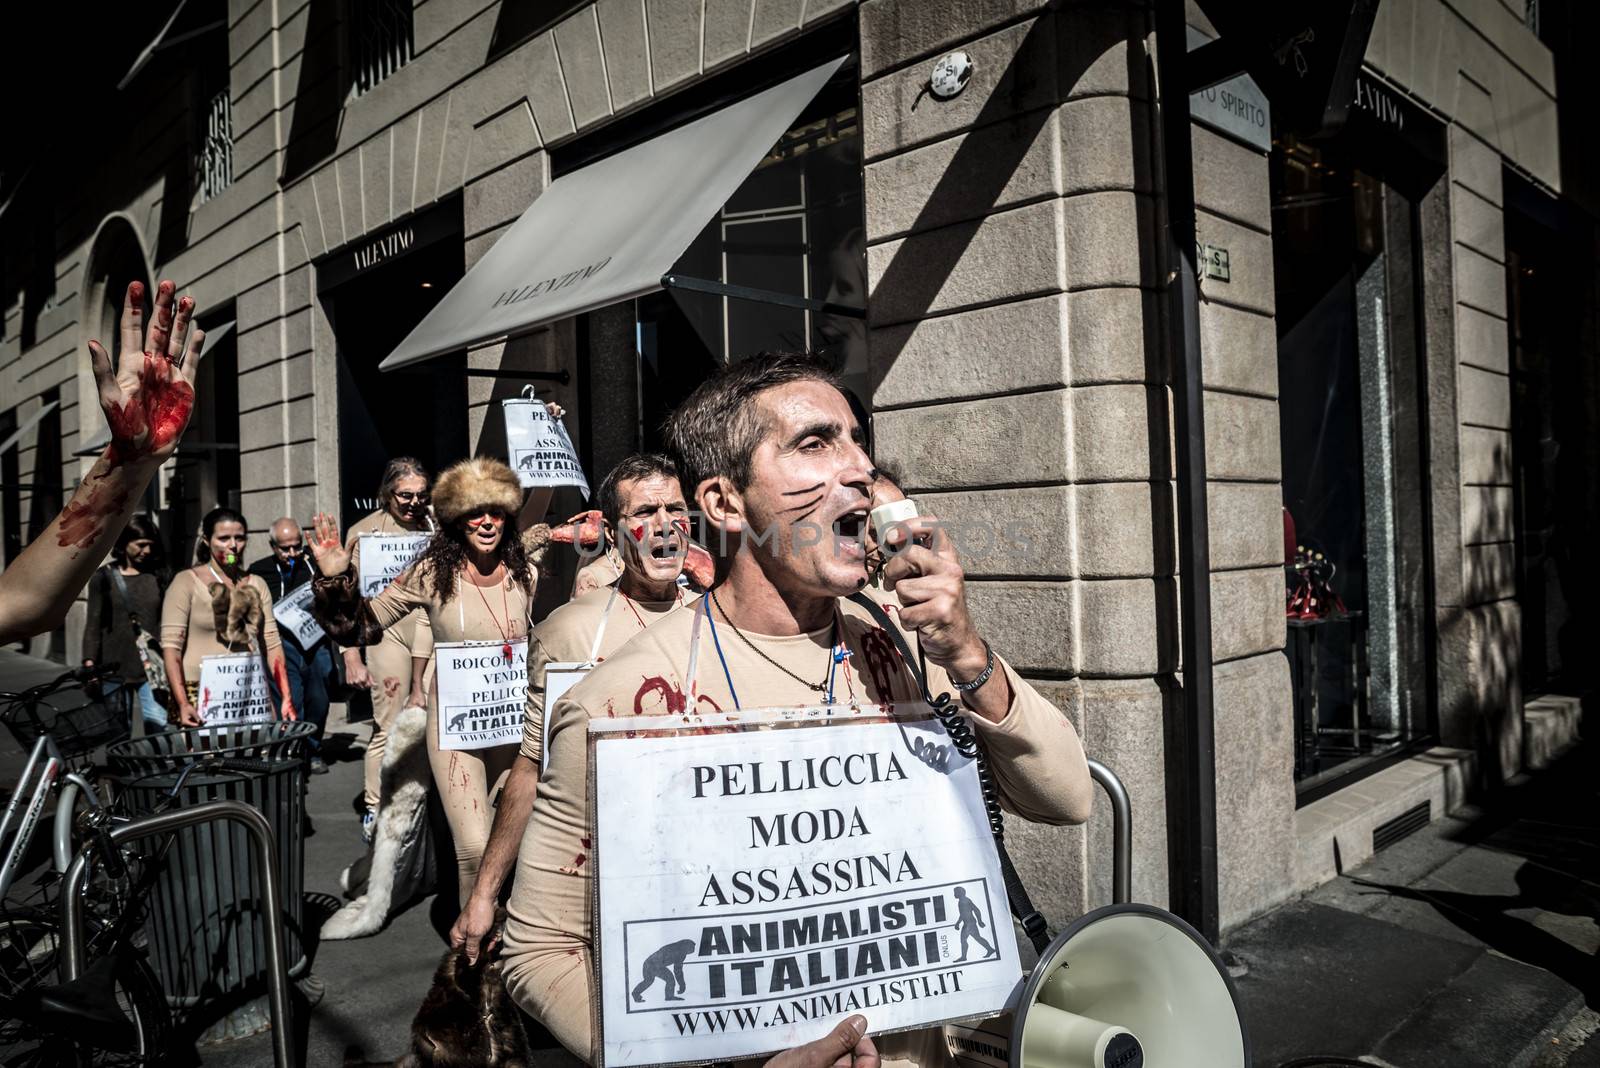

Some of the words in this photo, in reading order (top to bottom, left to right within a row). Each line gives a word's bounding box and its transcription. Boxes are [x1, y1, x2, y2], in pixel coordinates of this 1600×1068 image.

[1221, 90, 1265, 128] SPIRITO
[491, 256, 612, 309] VALENTINO
[468, 702, 526, 718] ANIMAL
[691, 751, 909, 798] PELLICCIA
[747, 805, 871, 848] MODA
[698, 850, 923, 907] ASSASSINA
[698, 894, 946, 957] ANIMALISTI
[940, 934, 950, 959] ONLUS
[707, 931, 941, 999] ITALIANI
[672, 970, 964, 1036] WWW.ANIMALISTI.IT
